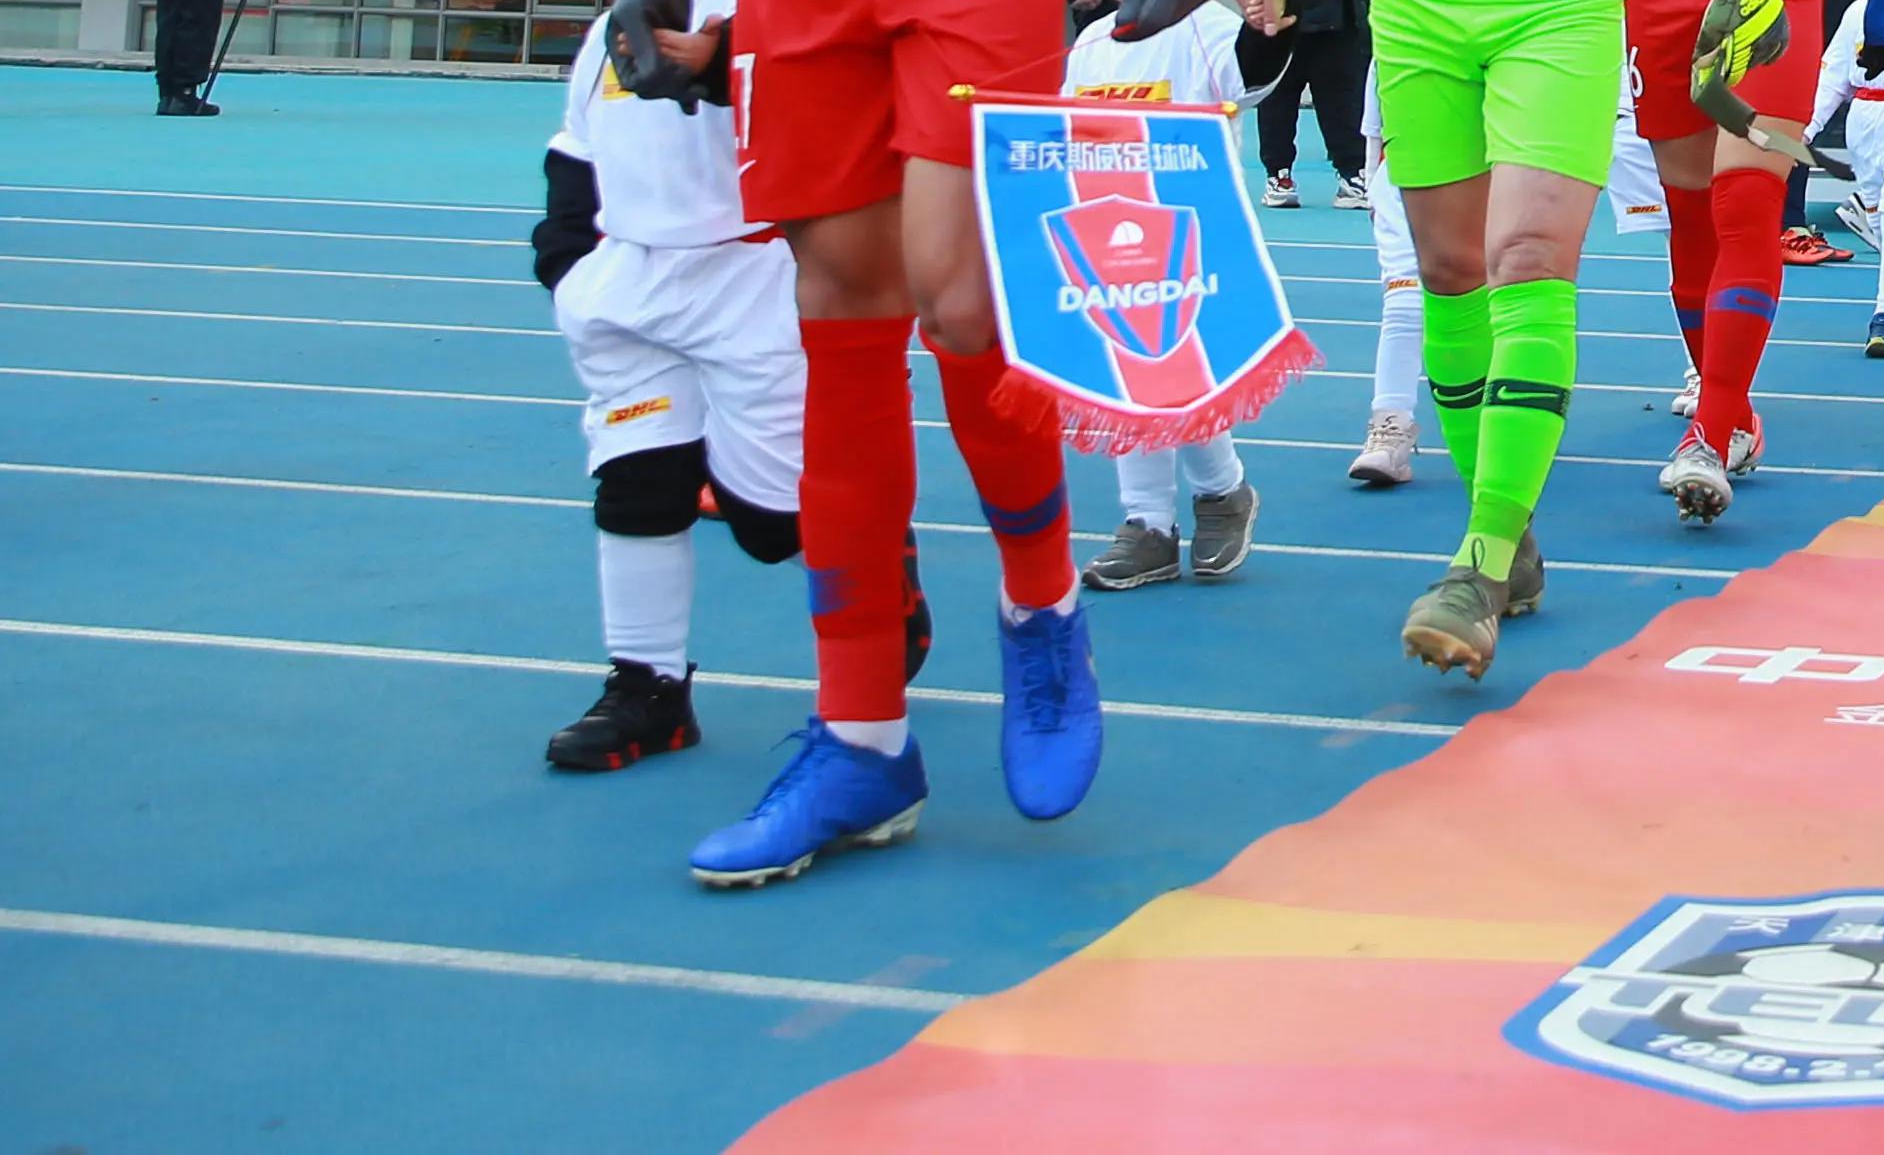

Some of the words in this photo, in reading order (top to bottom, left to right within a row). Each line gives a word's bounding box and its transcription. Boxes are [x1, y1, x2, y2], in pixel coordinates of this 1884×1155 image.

[1008, 140, 1210, 172] 重庆斯威足球队
[1057, 273, 1219, 313] DANGDAI
[613, 399, 661, 422] DHL
